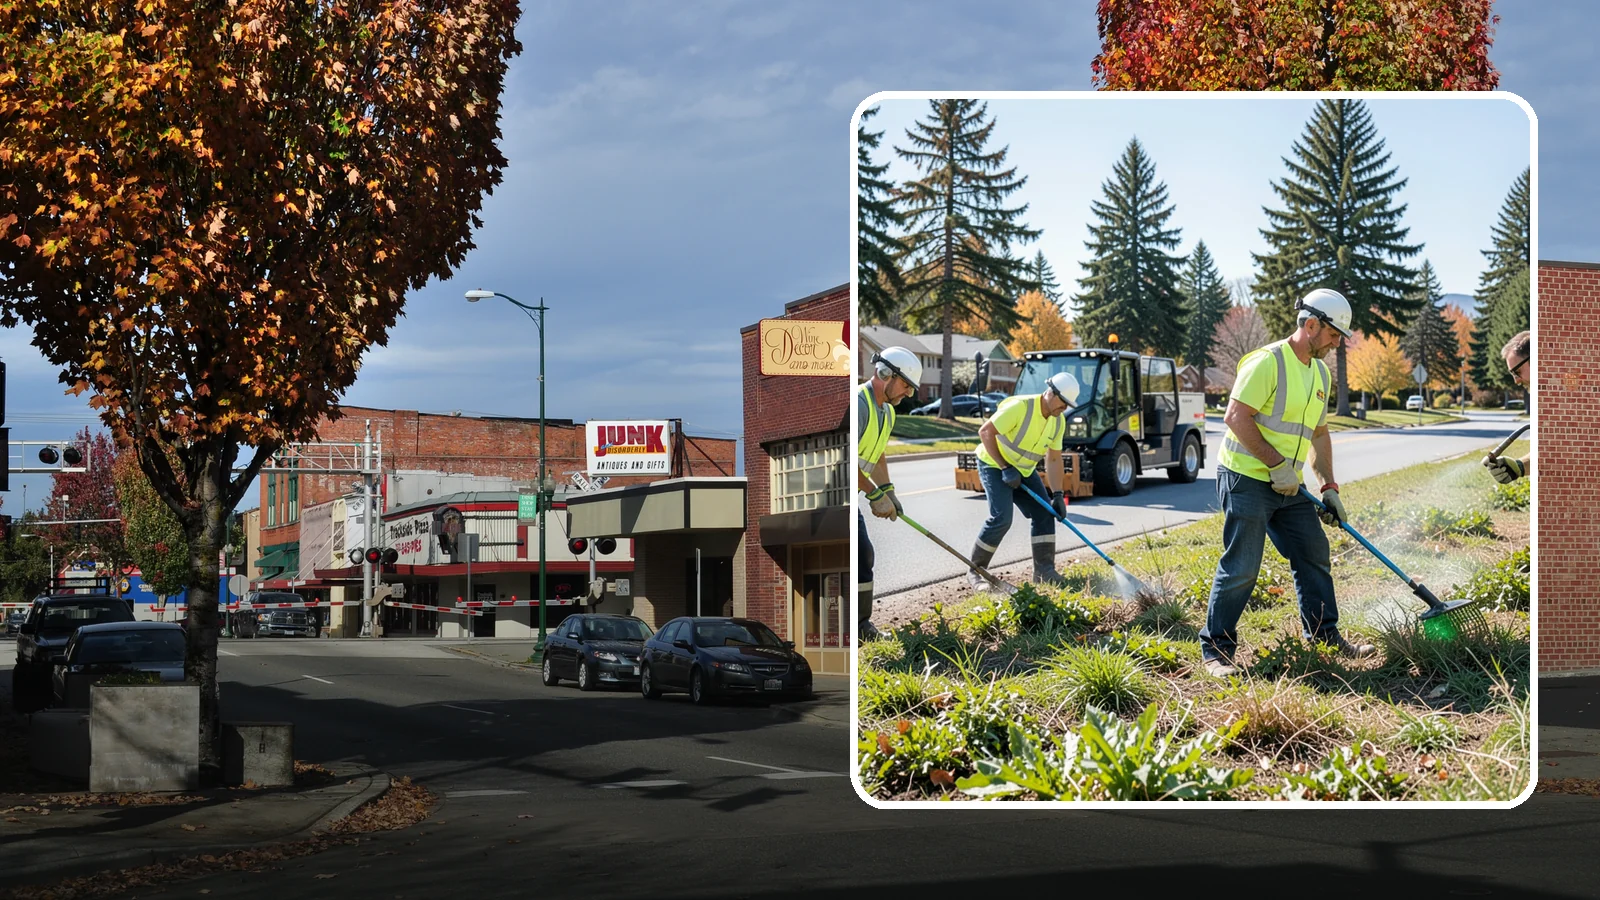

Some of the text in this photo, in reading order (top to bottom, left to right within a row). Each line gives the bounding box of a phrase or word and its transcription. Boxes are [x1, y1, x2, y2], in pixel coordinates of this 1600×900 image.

[595, 425, 665, 457] JUNK
[607, 446, 645, 454] DISORDERLY
[596, 460, 665, 470] ANTIQUES AND GIFTS
[391, 519, 429, 540] Trackside Pizza
